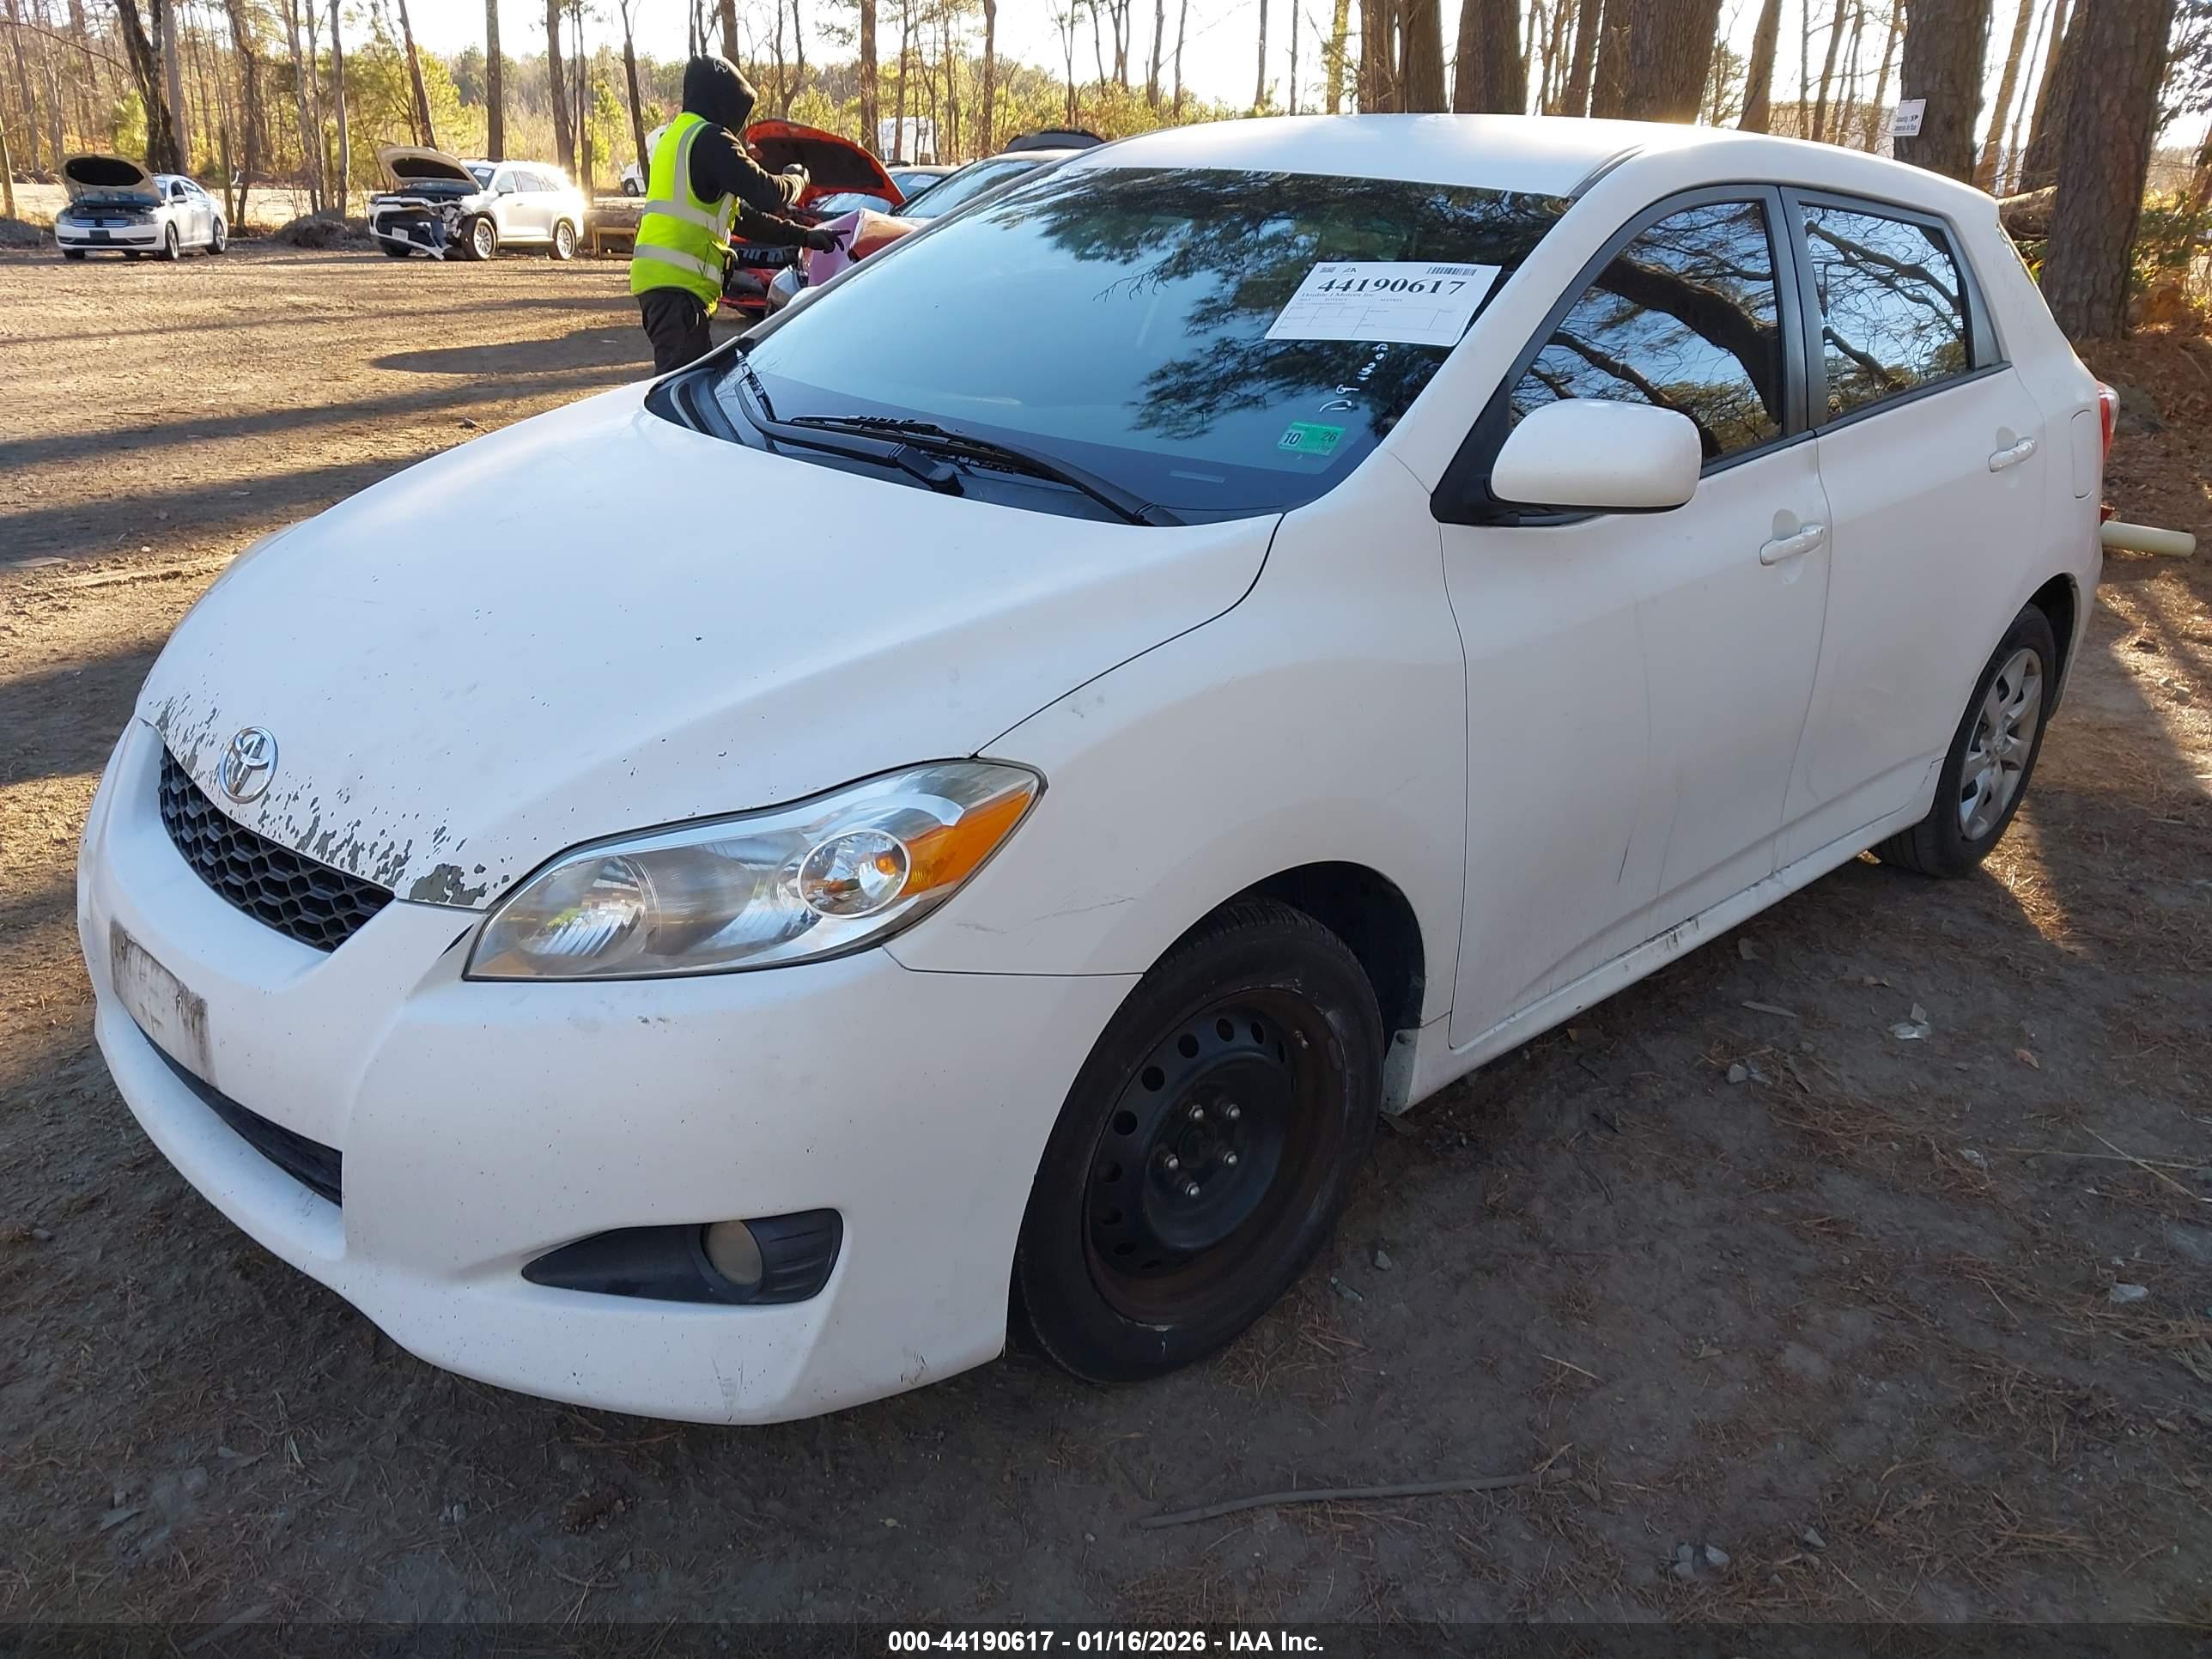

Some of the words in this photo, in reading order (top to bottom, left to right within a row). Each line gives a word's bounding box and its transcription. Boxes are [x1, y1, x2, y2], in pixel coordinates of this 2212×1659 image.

[1317, 277, 1468, 295] 44190617
[1283, 432, 1302, 445] 10
[1321, 432, 1338, 442] 26
